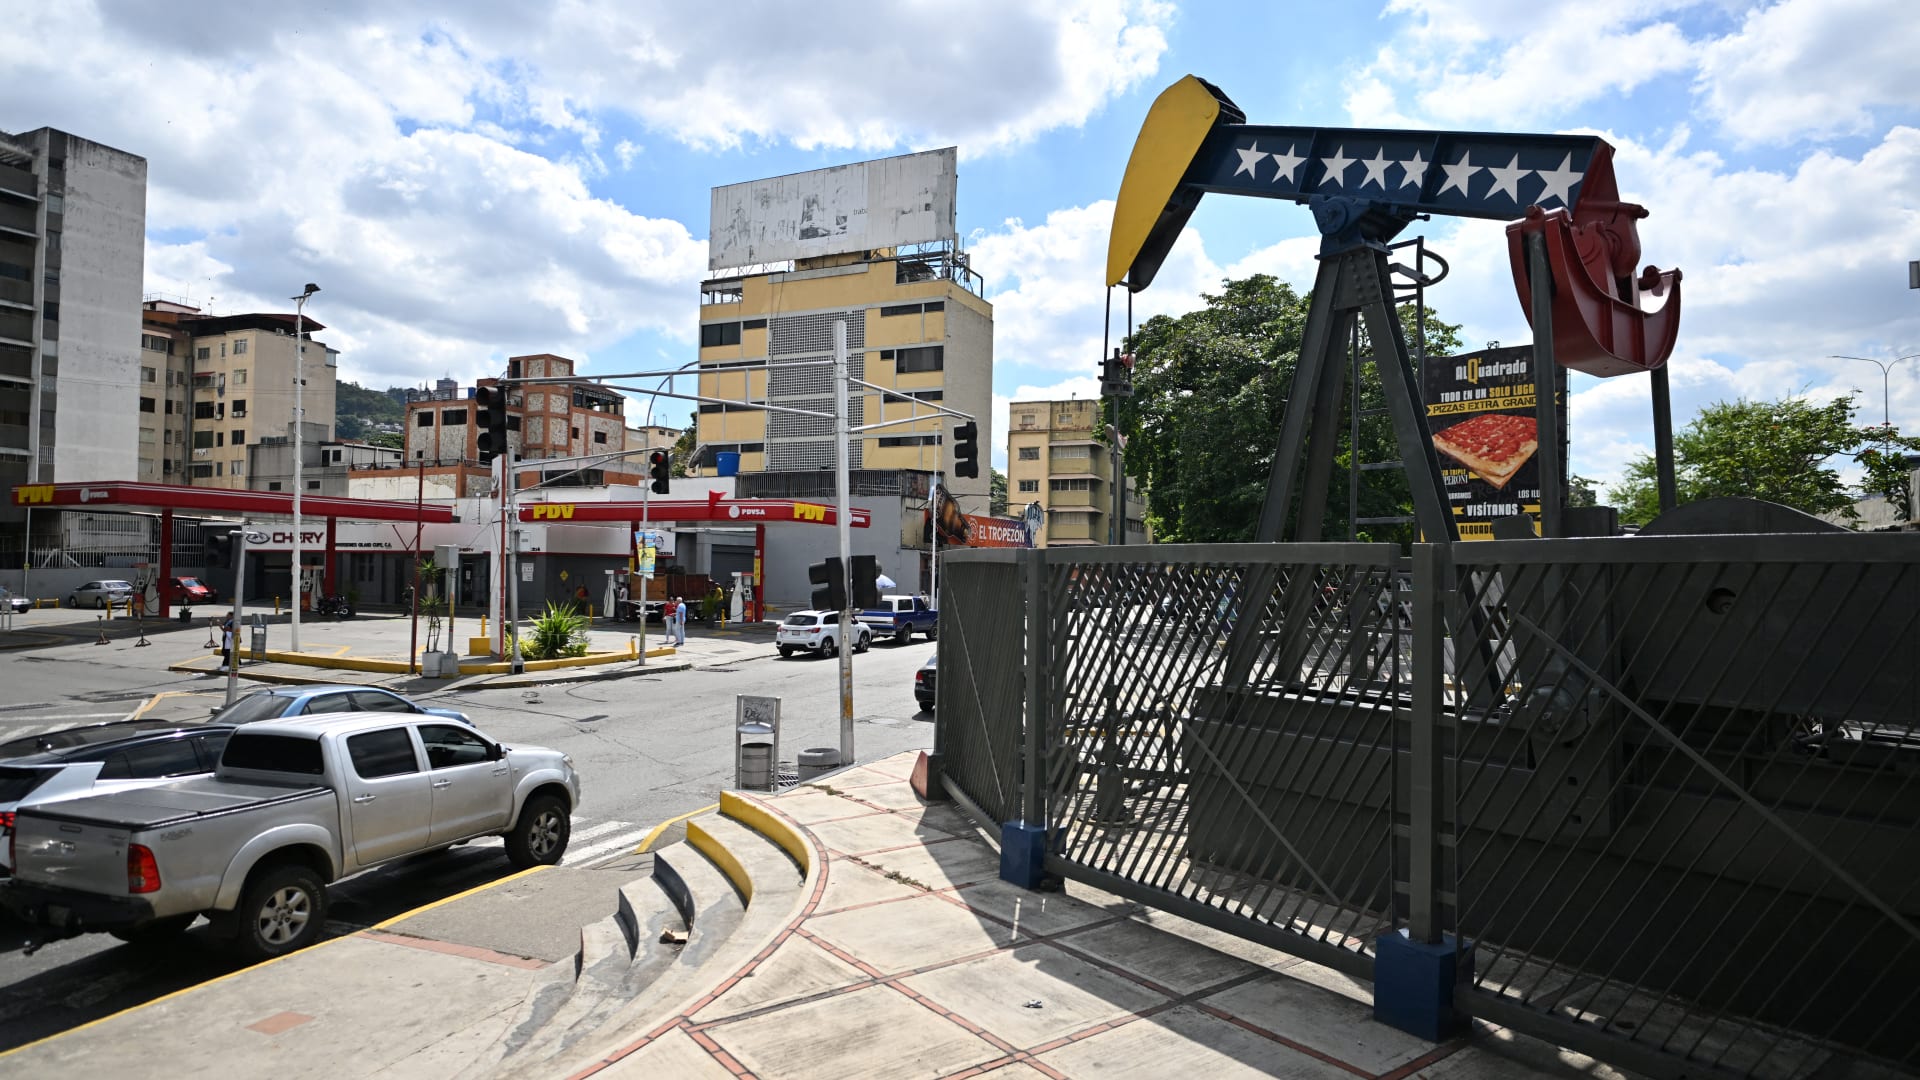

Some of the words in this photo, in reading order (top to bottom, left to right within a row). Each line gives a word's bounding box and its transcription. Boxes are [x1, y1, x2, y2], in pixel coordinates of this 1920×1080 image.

[1441, 391, 1460, 403] TODO
[1463, 390, 1473, 400] EN
[1475, 388, 1487, 399] UN
[1489, 385, 1510, 397] SOLO
[1513, 383, 1535, 395] LUGA
[1433, 403, 1465, 413] PIZZAS
[1468, 400, 1499, 410] EXTRA
[1502, 397, 1536, 407] GRAND
[18, 485, 55, 504] PDV
[1518, 489, 1530, 499] LOS
[533, 504, 576, 519] PDV
[793, 502, 826, 521] PDV
[1466, 501, 1518, 517] VISÍTANOS
[978, 525, 987, 540] EL
[989, 525, 1025, 543] TROPEZÓN
